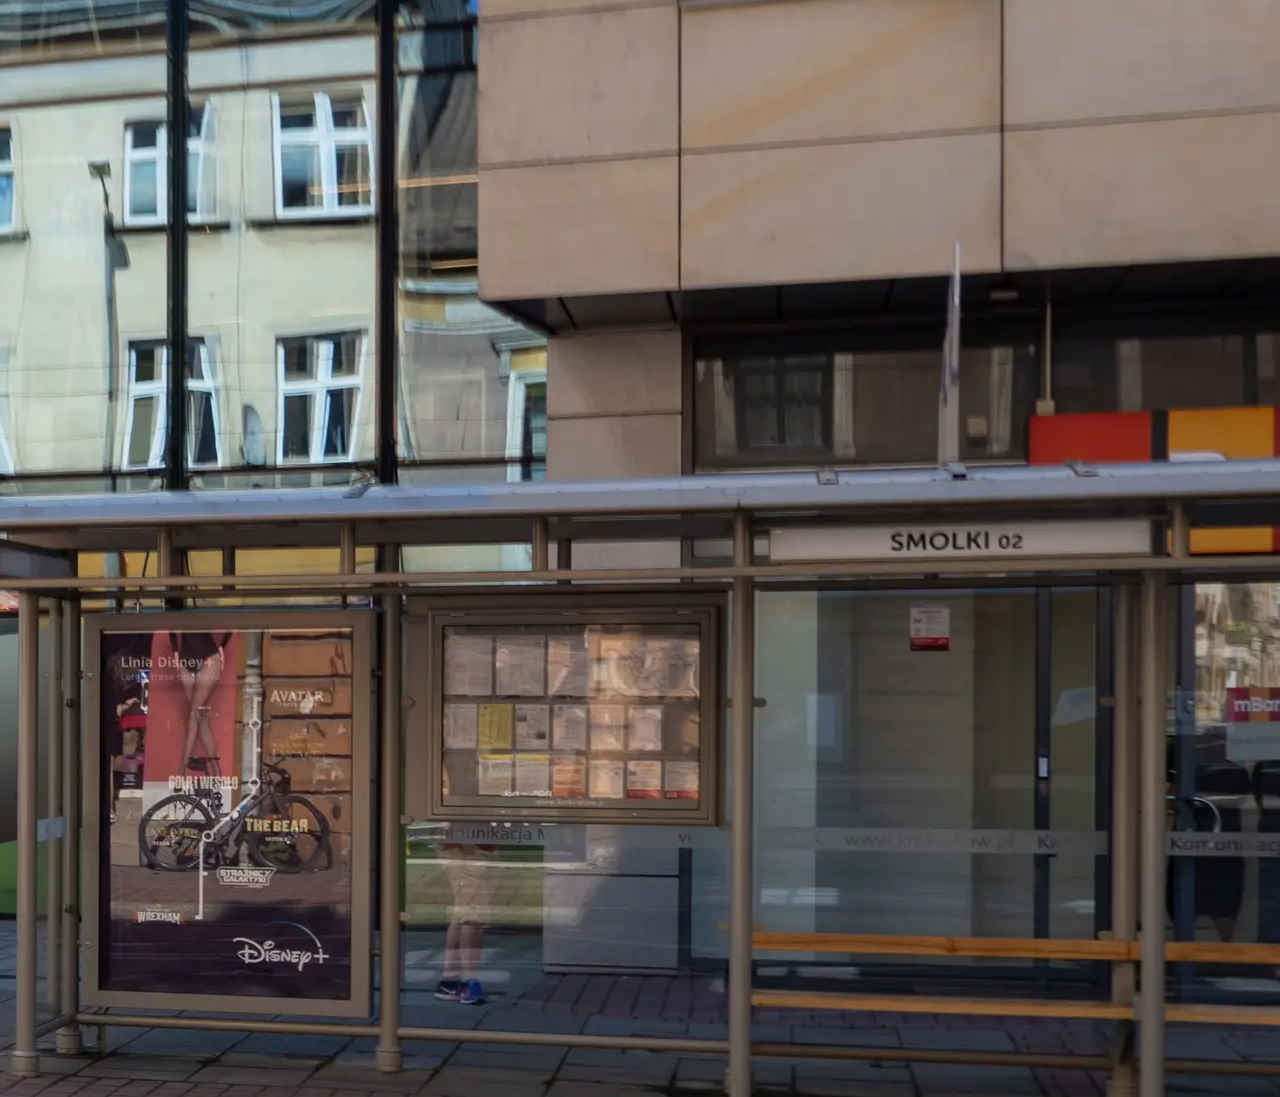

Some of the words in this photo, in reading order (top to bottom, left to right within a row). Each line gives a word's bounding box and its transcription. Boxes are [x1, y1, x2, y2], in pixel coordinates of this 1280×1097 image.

[890, 530, 990, 552] SMOLKI
[997, 534, 1024, 550] 02
[120, 656, 154, 669] Linia
[157, 656, 216, 671] Disney+
[269, 689, 325, 703] AVATAR
[244, 817, 272, 832] THE
[272, 818, 309, 833] BEAR
[137, 911, 181, 925] WREXHAM
[232, 937, 330, 972] Disney+
